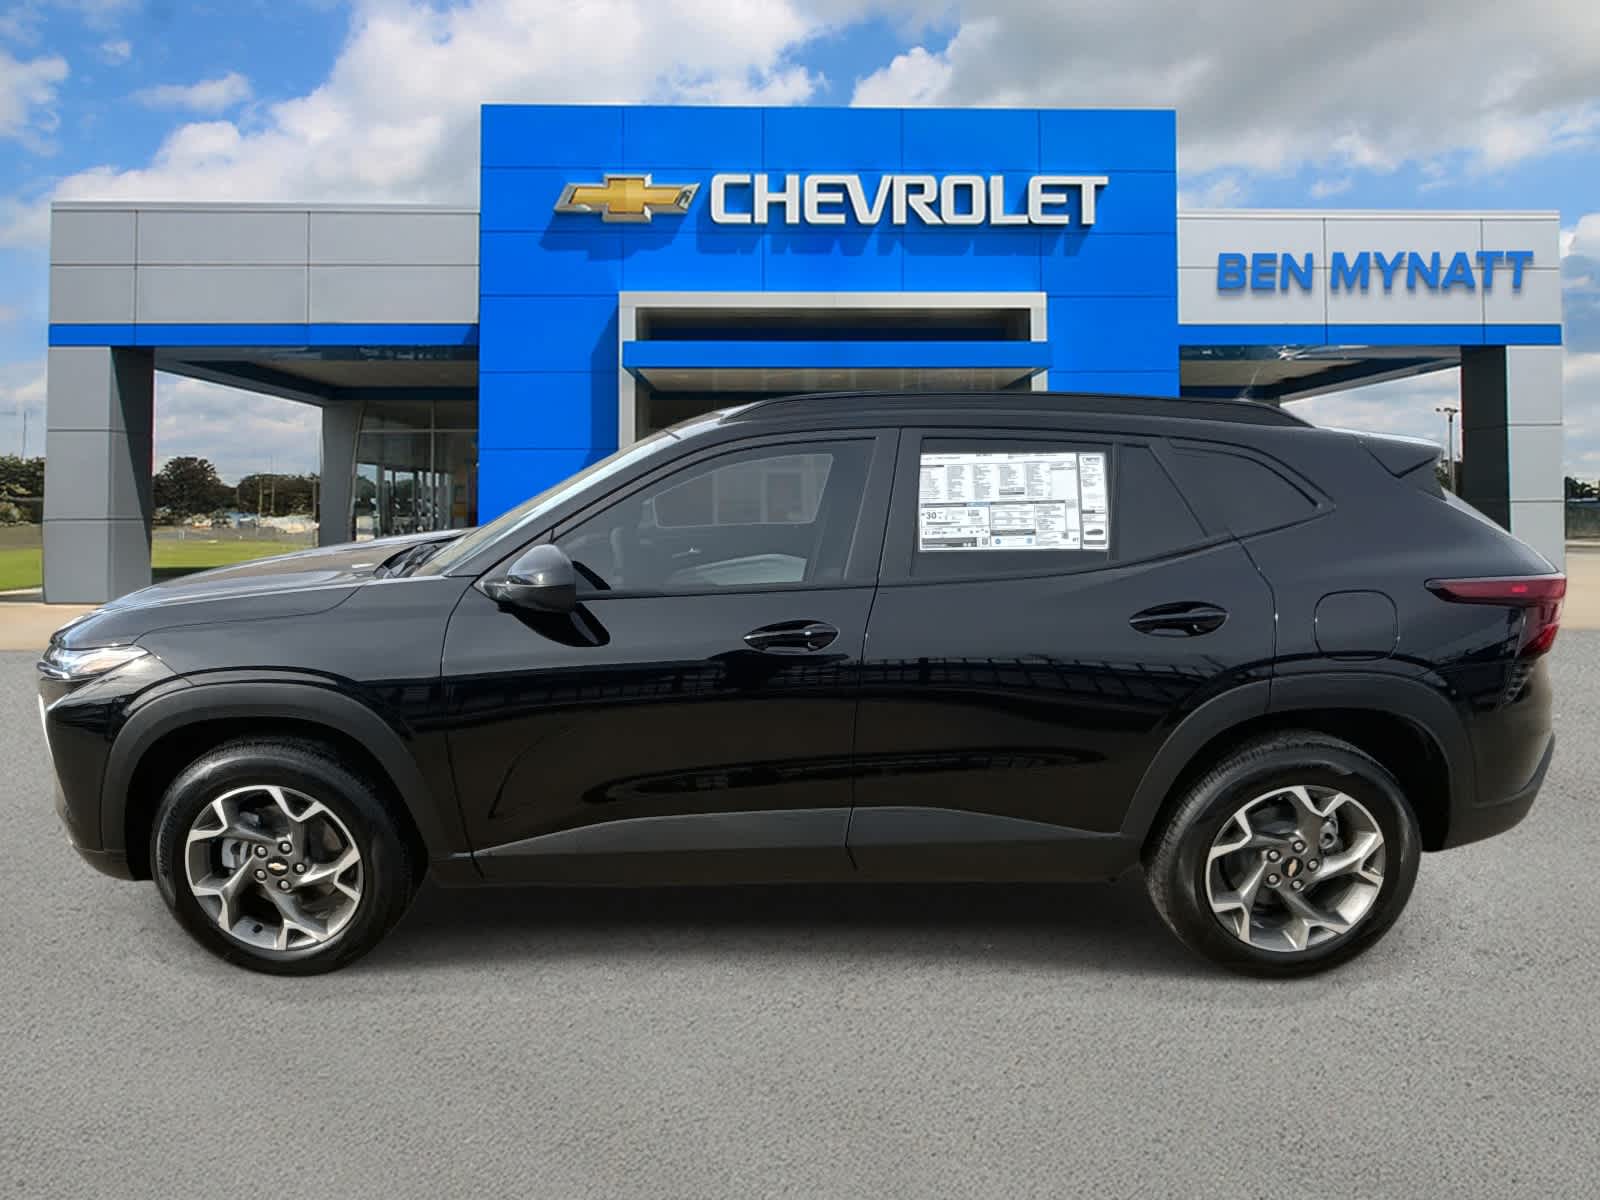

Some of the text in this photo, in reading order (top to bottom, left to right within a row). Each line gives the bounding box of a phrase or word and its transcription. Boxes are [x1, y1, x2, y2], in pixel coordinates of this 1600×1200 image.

[711, 174, 1109, 225] CHEVROLET
[1217, 251, 1534, 291] BEN MYNATT
